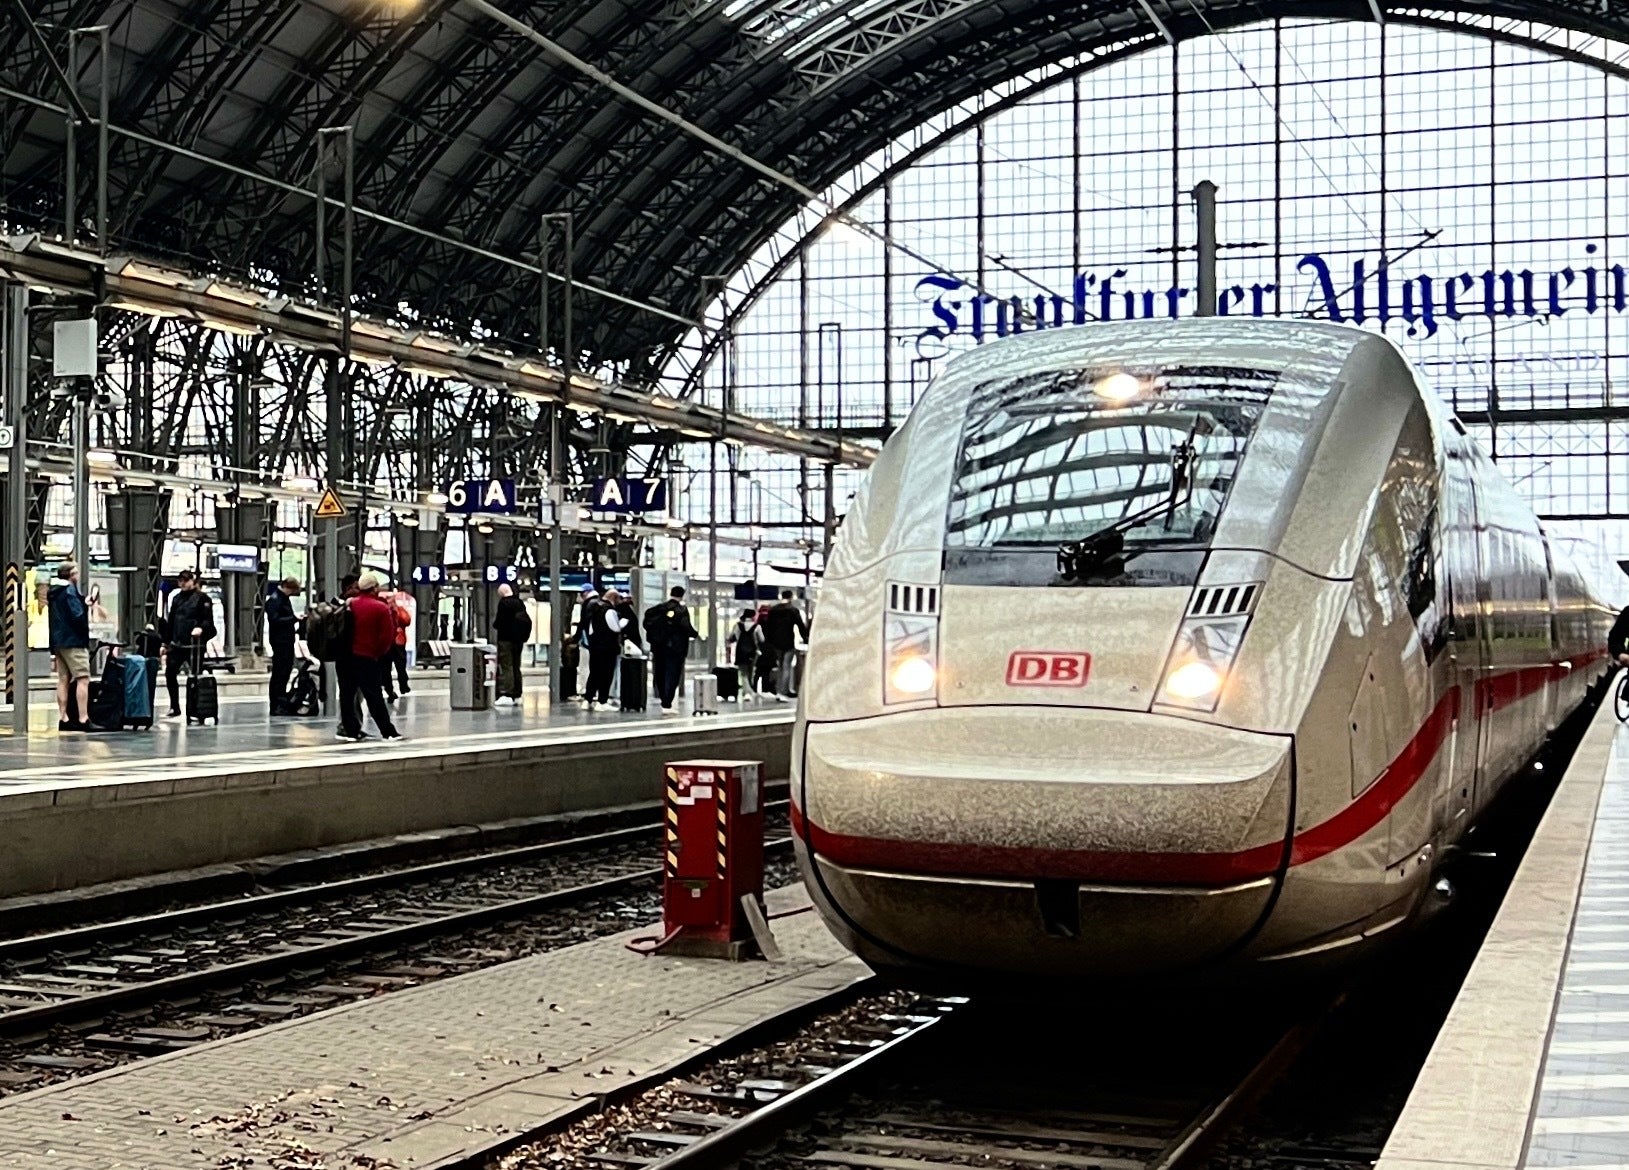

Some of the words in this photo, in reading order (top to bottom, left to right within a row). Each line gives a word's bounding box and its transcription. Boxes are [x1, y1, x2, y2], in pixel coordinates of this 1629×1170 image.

[914, 270, 1276, 346] Frankfurer
[448, 480, 467, 507] 6
[484, 479, 508, 507] A
[600, 478, 624, 506] A
[643, 478, 660, 504] 7
[412, 566, 423, 582] 4
[429, 566, 442, 582] B
[486, 566, 498, 582] B
[506, 566, 517, 581] 5
[1016, 657, 1080, 682] DB
